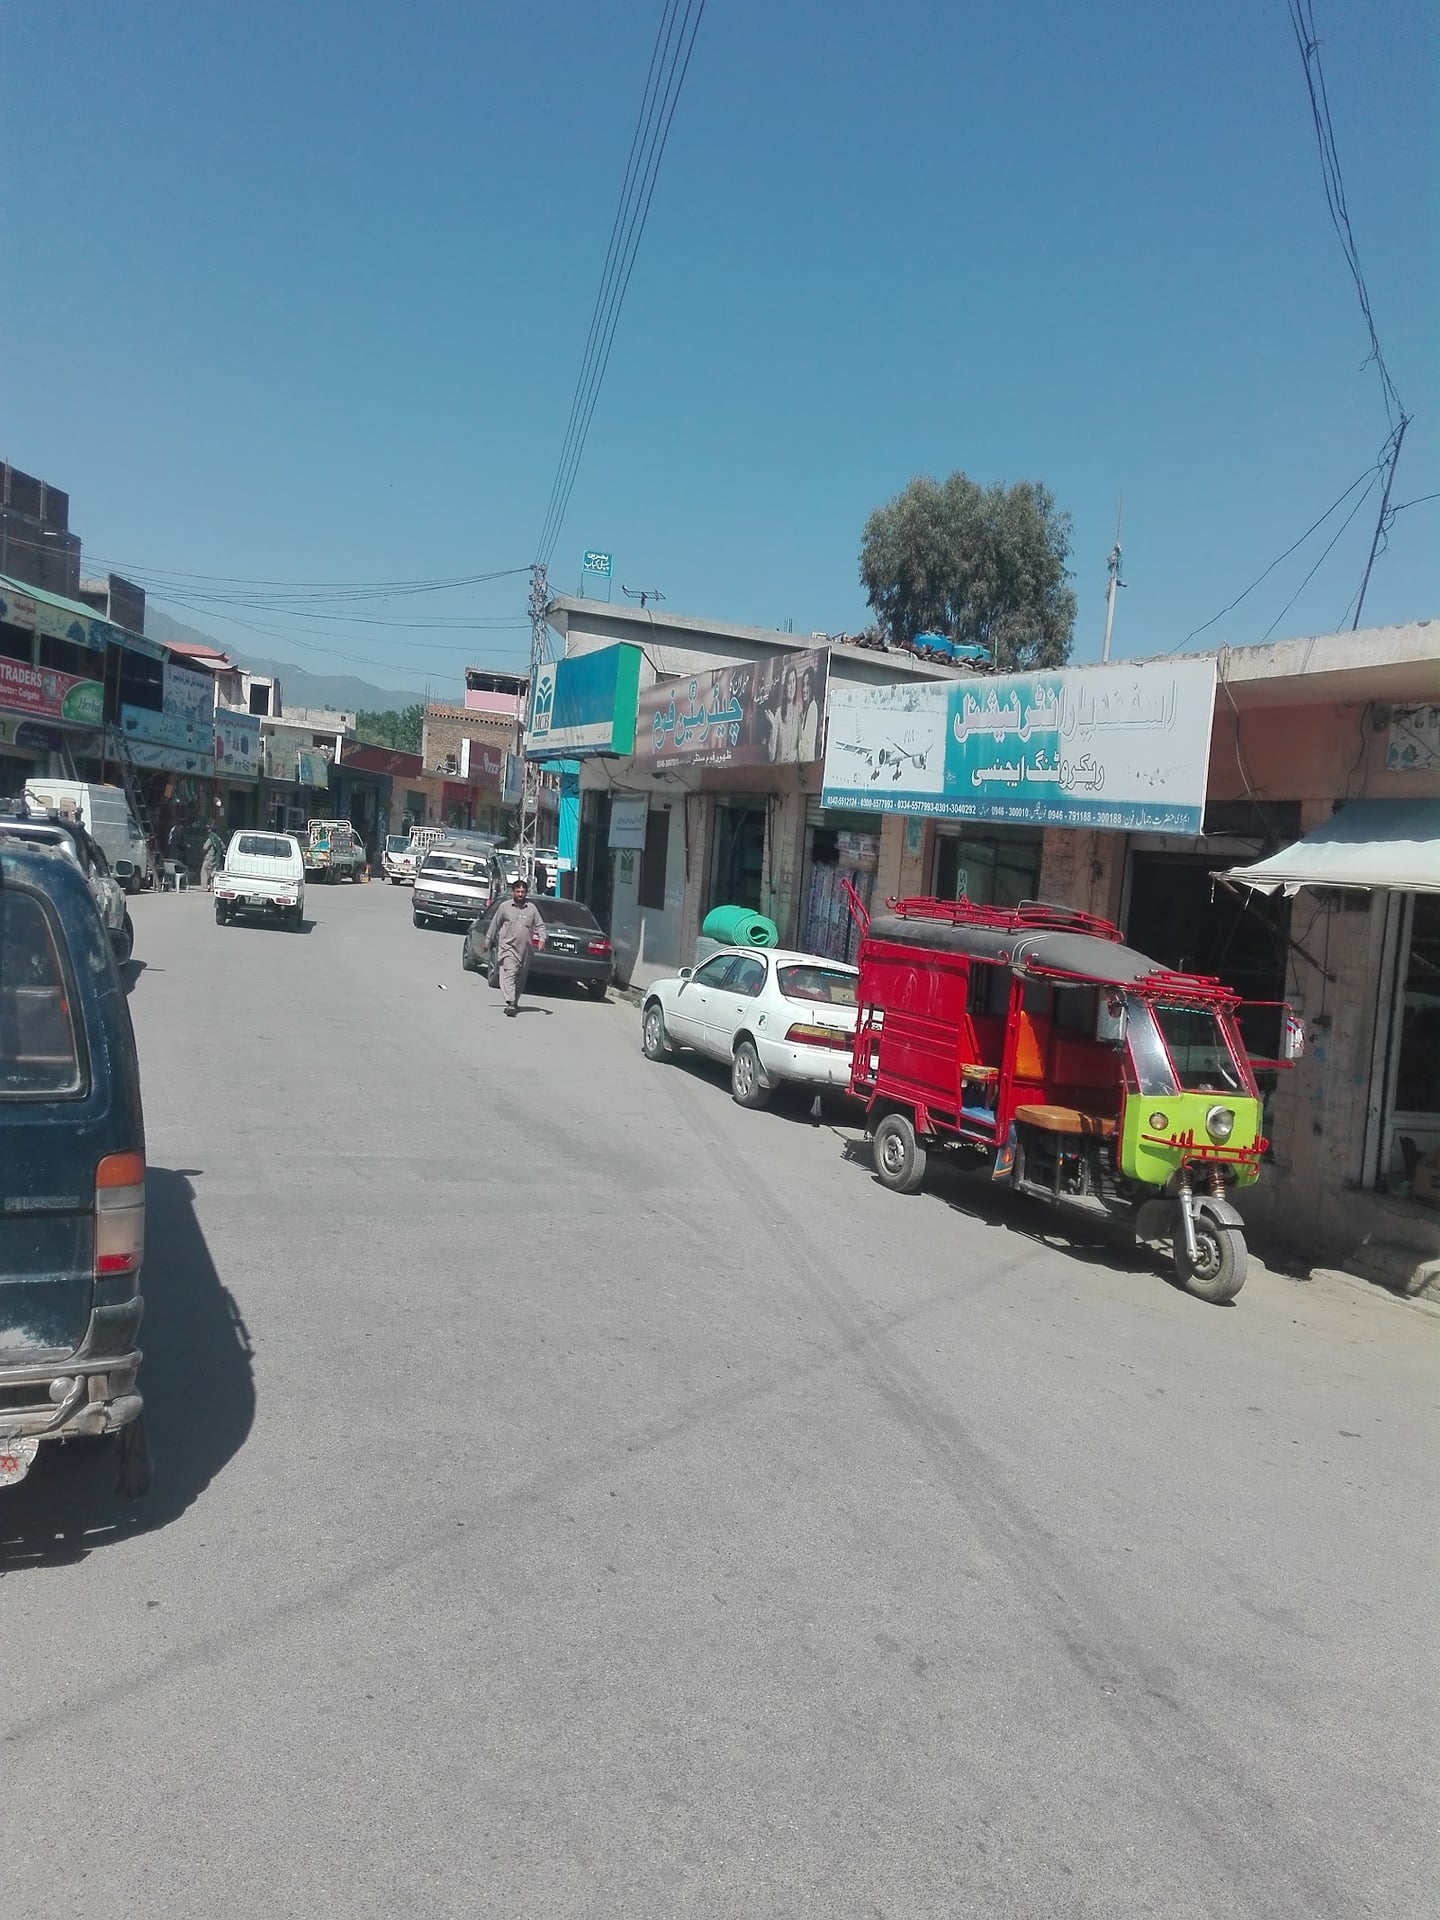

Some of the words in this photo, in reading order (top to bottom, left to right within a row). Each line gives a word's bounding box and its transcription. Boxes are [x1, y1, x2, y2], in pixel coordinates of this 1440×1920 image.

[0, 663, 42, 688] TRADERS
[652, 687, 675, 749] فوم
[953, 683, 1068, 743] انٹرنیشنل
[534, 713, 551, 731] MCB
[971, 755, 1026, 789] ایجنسی
[991, 805, 1005, 816] 0946
[1008, 806, 1029, 818] 300010
[1047, 809, 1064, 821] 0946
[1068, 810, 1092, 822] 791188
[1096, 812, 1122, 824] 300188
